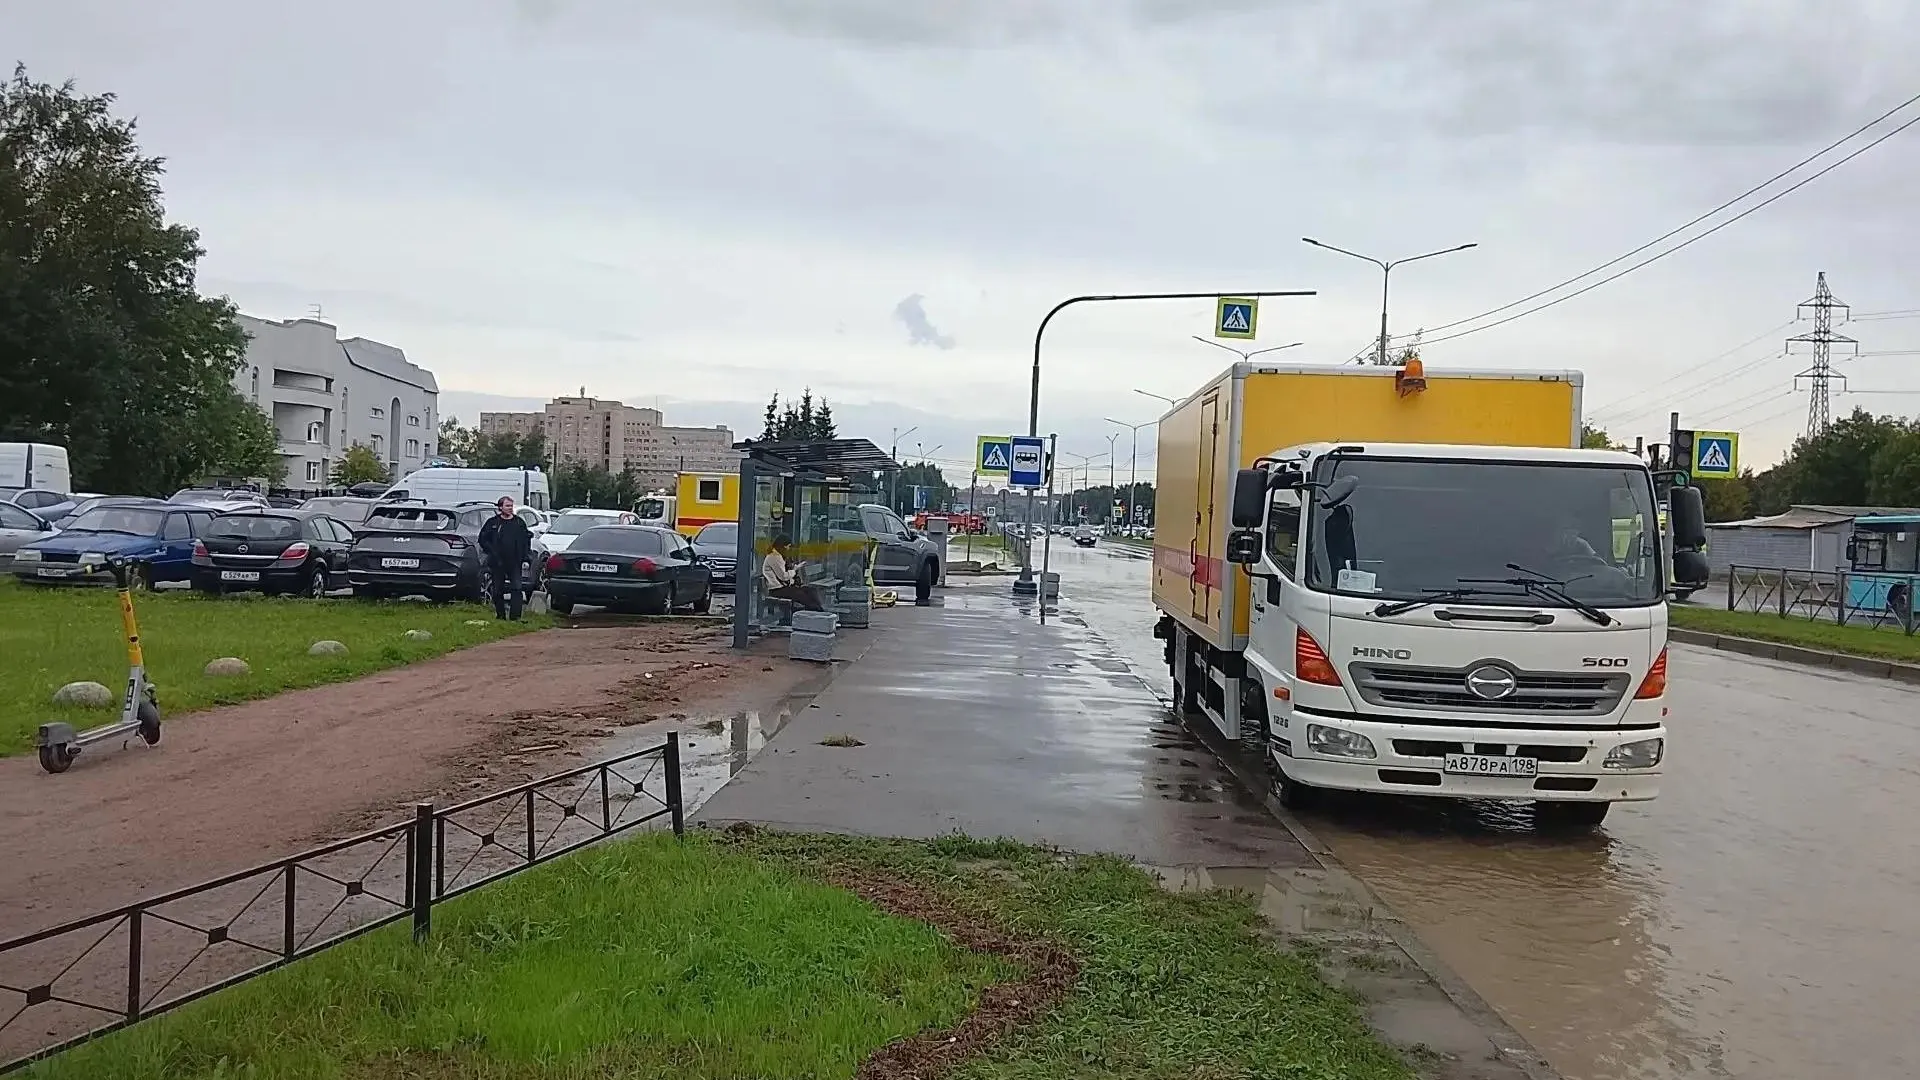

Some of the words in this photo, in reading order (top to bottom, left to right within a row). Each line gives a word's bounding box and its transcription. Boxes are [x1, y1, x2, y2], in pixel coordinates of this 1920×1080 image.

[1352, 646, 1411, 660] HINO
[1582, 657, 1628, 667] 500
[1273, 714, 1289, 728] 1226
